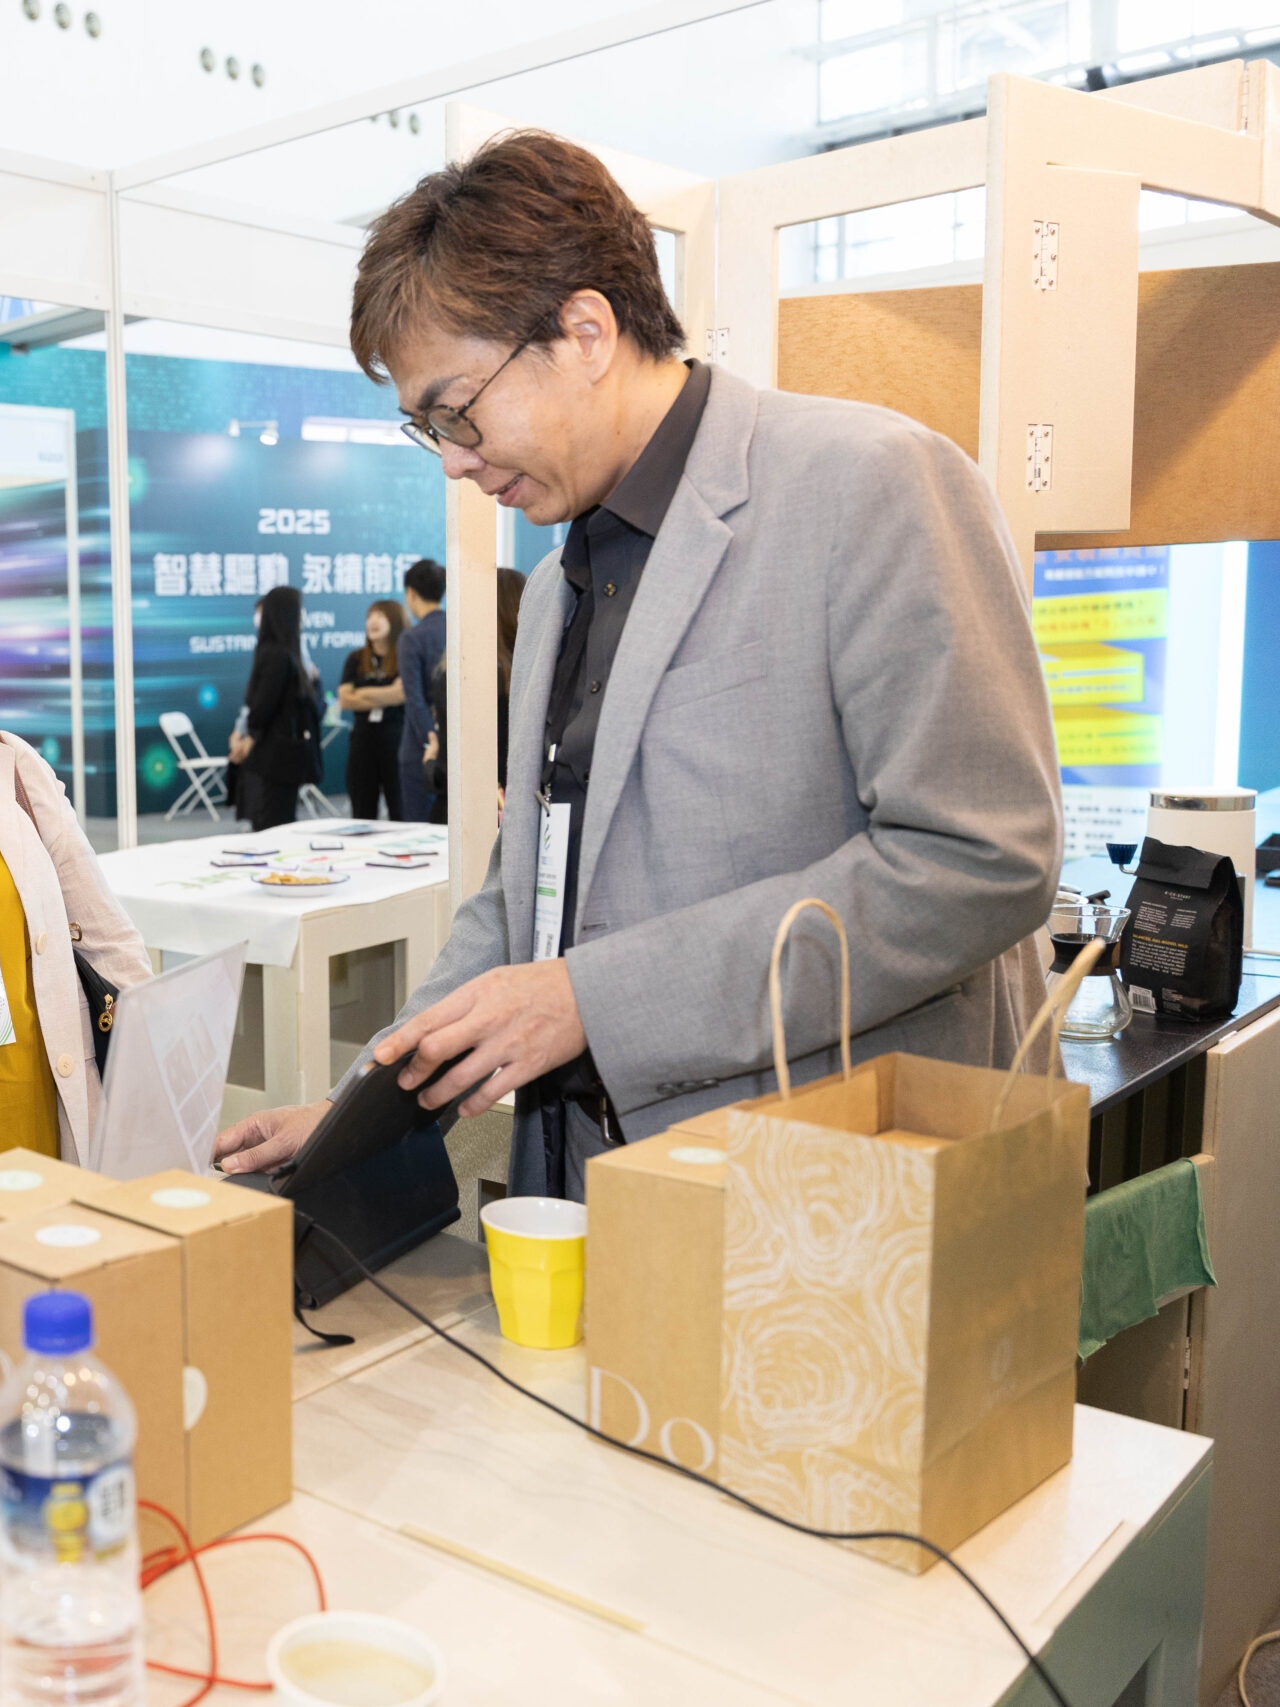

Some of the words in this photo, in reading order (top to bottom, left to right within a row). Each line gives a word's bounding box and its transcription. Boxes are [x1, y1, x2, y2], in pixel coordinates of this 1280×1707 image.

[257, 507, 332, 535] 2025
[153, 552, 290, 597] 智慧驅動
